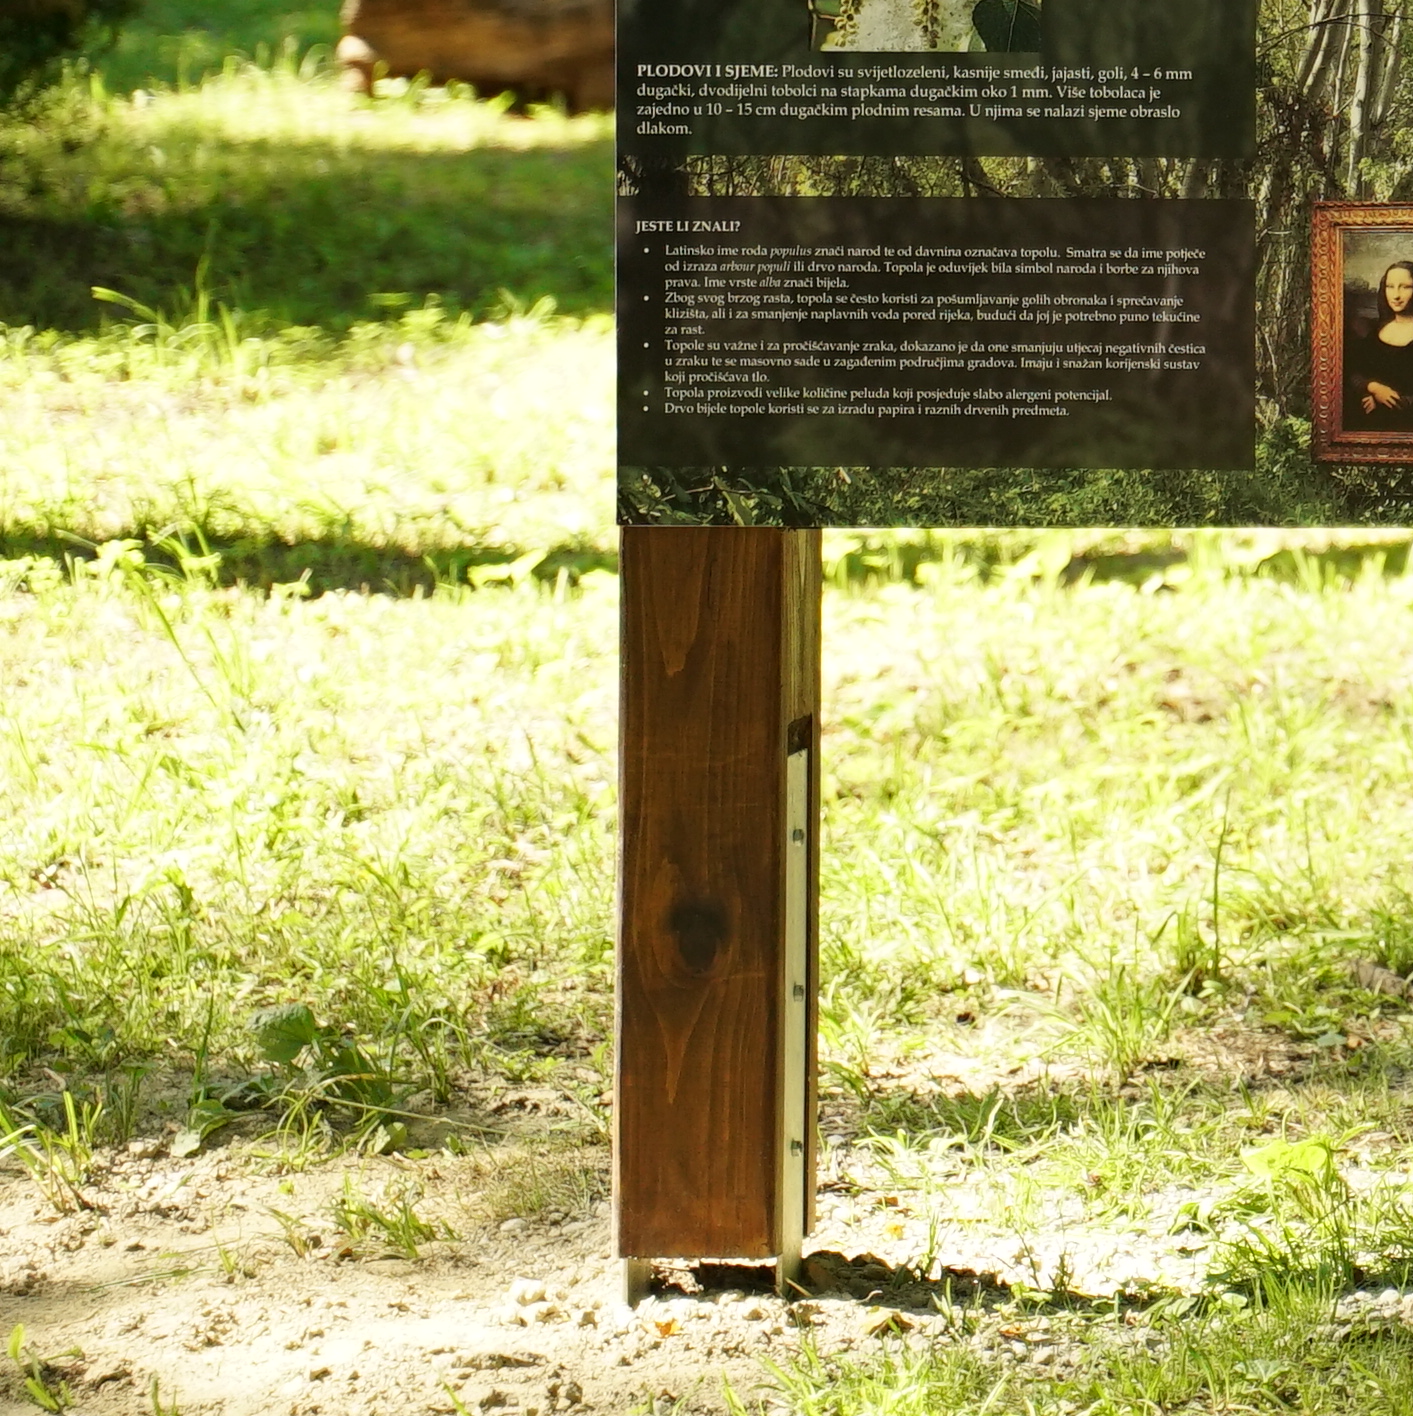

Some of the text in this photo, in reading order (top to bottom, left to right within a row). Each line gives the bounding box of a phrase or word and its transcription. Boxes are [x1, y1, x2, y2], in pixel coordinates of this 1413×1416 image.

[637, 63, 711, 78] PLODOVI
[715, 64, 721, 77] I
[724, 64, 778, 80] SJEME:
[781, 64, 834, 77] Plodovi
[837, 68, 853, 77] su
[857, 64, 949, 81] svijetlozeleni,
[953, 64, 1000, 82] kasnije
[1003, 65, 1048, 81] smeđi,
[1051, 66, 1094, 82] jajasti,
[1097, 65, 1127, 83] goli,
[1130, 66, 1139, 79] 4
[1153, 67, 1162, 79] 6
[1165, 70, 1192, 79] mm
[636, 120, 692, 134] dlakom.
[635, 220, 740, 234] JESTE LI ZNALI?
[664, 325, 705, 334] za rast.
[664, 370, 769, 385] koji pročišćava tlo.
[663, 386, 1112, 405] Topola proizvodi velike količine peluda koji posjeduje slabo alergeni potencijal.
[664, 402, 694, 413] Drvo
[696, 402, 727, 416] bijele
[729, 402, 765, 417] topole
[767, 402, 804, 414] koristi
[806, 405, 819, 414] se
[821, 405, 834, 414] za
[837, 402, 874, 414] izradu
[877, 403, 915, 417] papira
[924, 403, 961, 415] raznih
[963, 403, 1009, 415] drvenih
[1011, 403, 1069, 418] predmeta.
